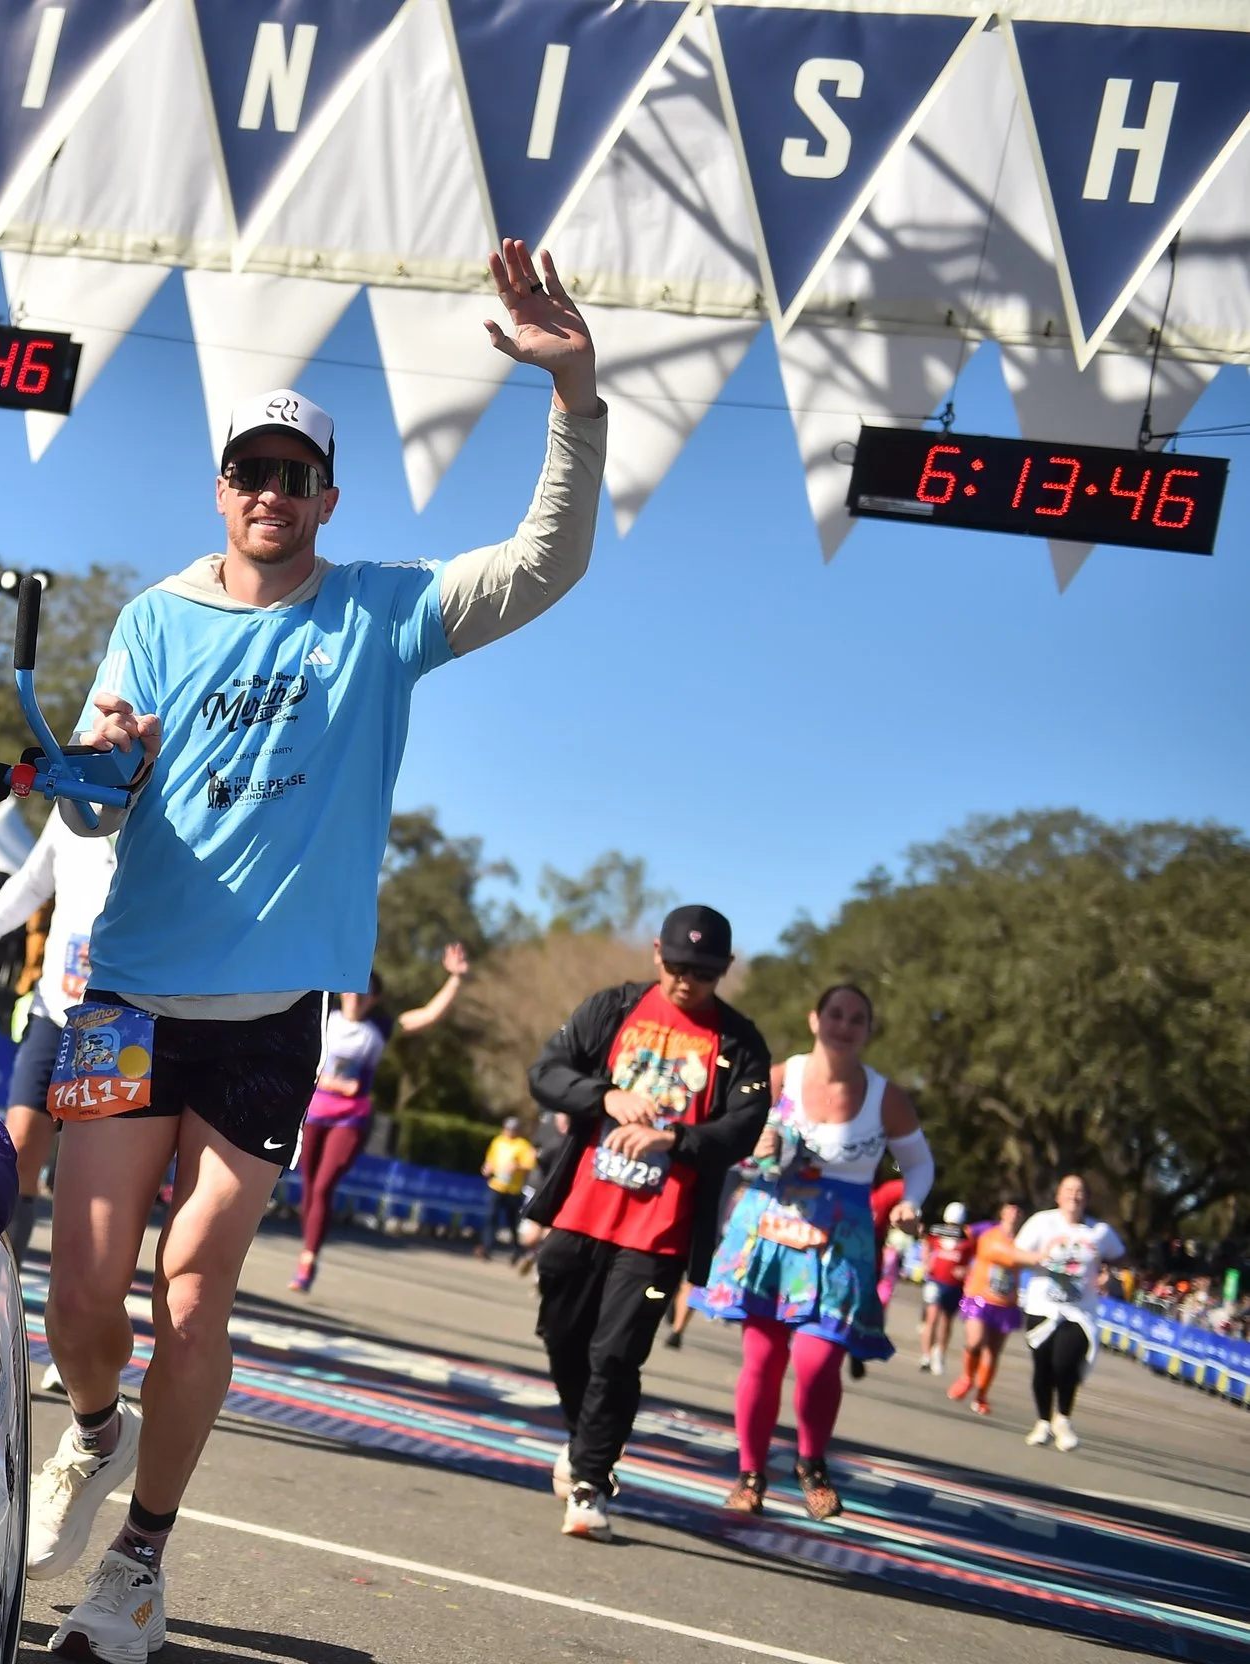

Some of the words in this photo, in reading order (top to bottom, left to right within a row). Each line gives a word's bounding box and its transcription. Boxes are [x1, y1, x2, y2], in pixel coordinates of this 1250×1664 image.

[264, 746, 293, 756] CHARITY
[234, 776, 250, 784] THE
[268, 773, 307, 791] PEASE
[234, 789, 284, 803] FOUNDATION
[54, 1078, 141, 1109] 16117
